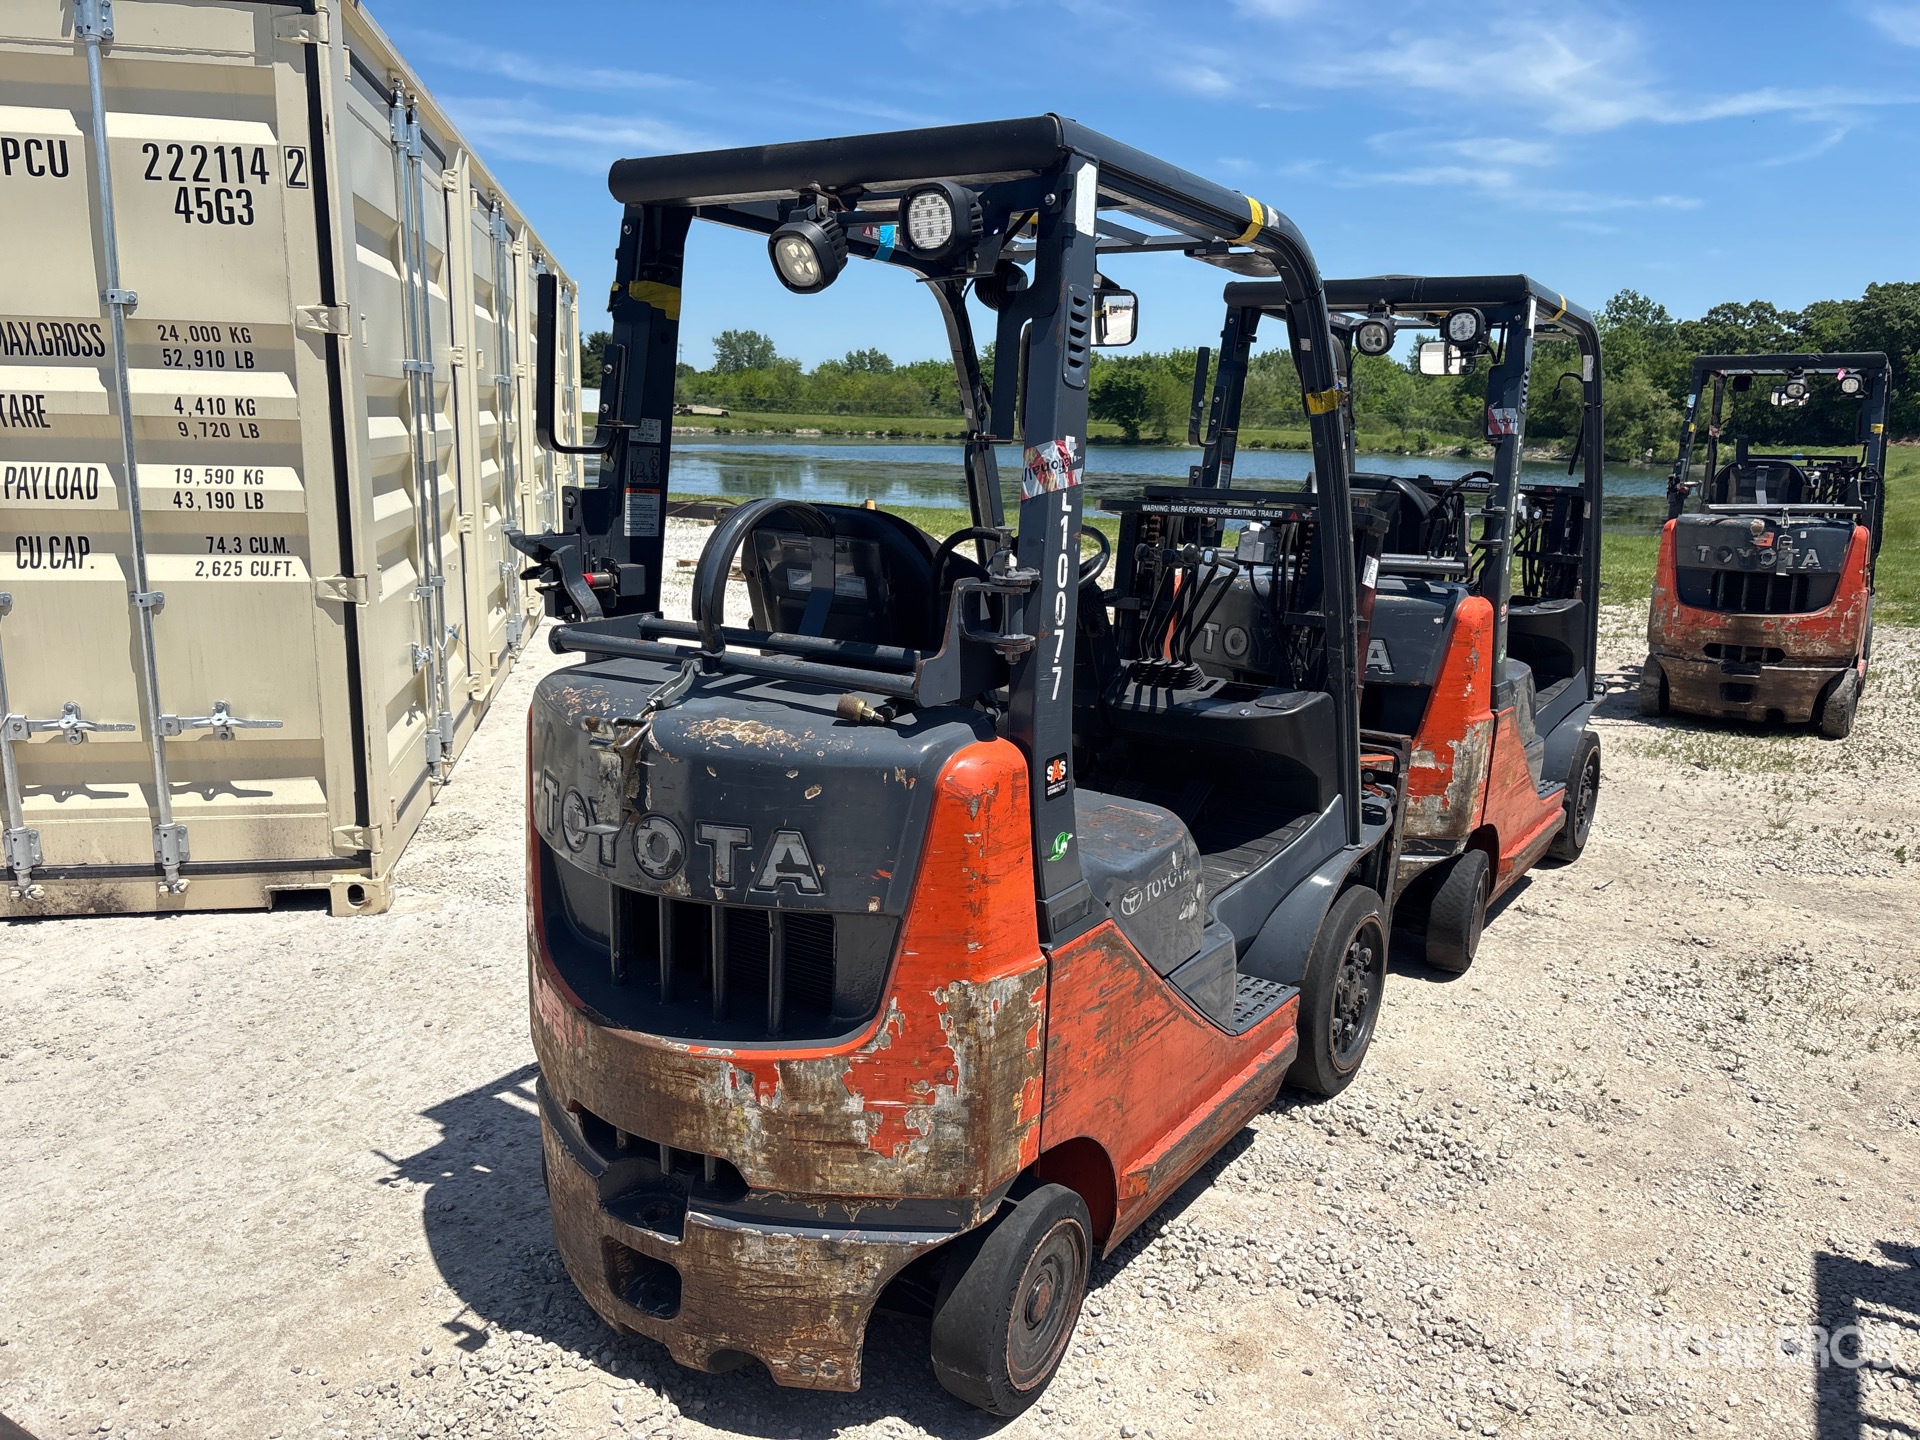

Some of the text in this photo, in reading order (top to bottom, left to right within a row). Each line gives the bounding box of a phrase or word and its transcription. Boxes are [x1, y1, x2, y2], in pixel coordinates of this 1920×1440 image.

[142, 143, 270, 185] 222114
[287, 148, 306, 186] 2
[174, 186, 255, 226] 45G3
[157, 325, 252, 344] 24,000 KG
[162, 349, 255, 369] 52,910 LB
[174, 397, 256, 417] 4,410 KG
[178, 422, 260, 440] 9,720 LB
[4, 466, 99, 500] PAYLOAD
[174, 468, 264, 487] 19,590 KG
[173, 491, 264, 511] 43,190 LB
[1142, 504, 1283, 518] WARNING: RAISE FORKS BEFORE EXITING TRAILER
[15, 536, 95, 570] CU.CAP.
[205, 536, 290, 554] 74.3 CU.M.
[195, 561, 296, 578] 2,625 CU.FT.
[1046, 759, 1067, 784] SAS
